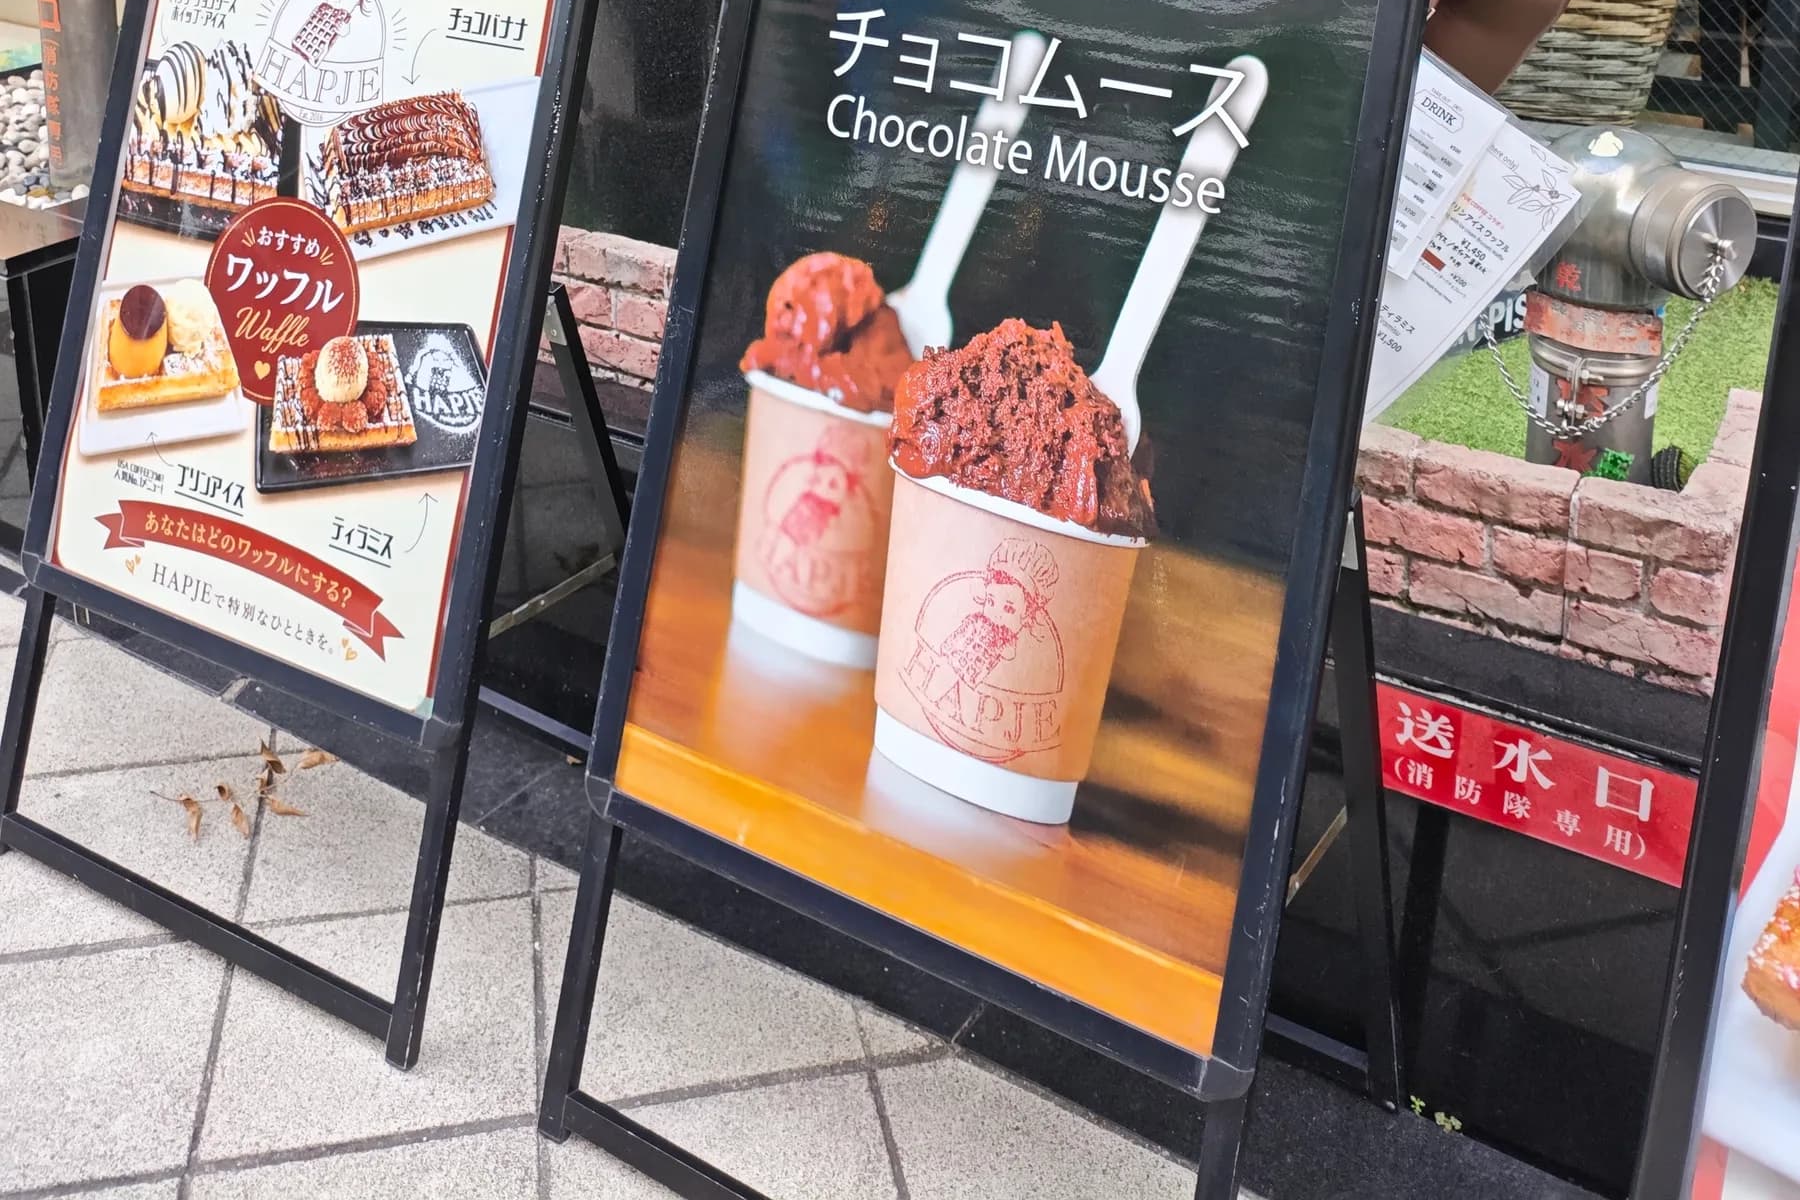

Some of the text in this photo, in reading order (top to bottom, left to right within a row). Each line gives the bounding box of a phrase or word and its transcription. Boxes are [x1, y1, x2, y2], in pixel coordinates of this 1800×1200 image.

[447, 8, 529, 42] チョコバナナ
[258, 45, 381, 105] HAPJE
[829, 8, 1251, 149] チョコムース
[1421, 96, 1456, 126] DRINK
[826, 94, 1226, 215] Chocolate Mousse
[257, 226, 320, 258] おすすめ
[1459, 238, 1486, 261] ¥1,450
[226, 253, 345, 313] ワッフル
[235, 307, 311, 354] Waffle
[1377, 331, 1402, 353] ¥1,500
[1381, 304, 1415, 334] ティラミス
[177, 464, 245, 509] プリンアイス
[144, 510, 353, 608] あなたはどのワッフルにする?
[331, 516, 394, 560] ティラミス
[151, 563, 335, 655] HAPJEで特別なひとときを。
[903, 645, 1062, 743] HAPJE
[1395, 702, 1655, 822] 送水口
[1393, 755, 1646, 861] (消防隊専用)
